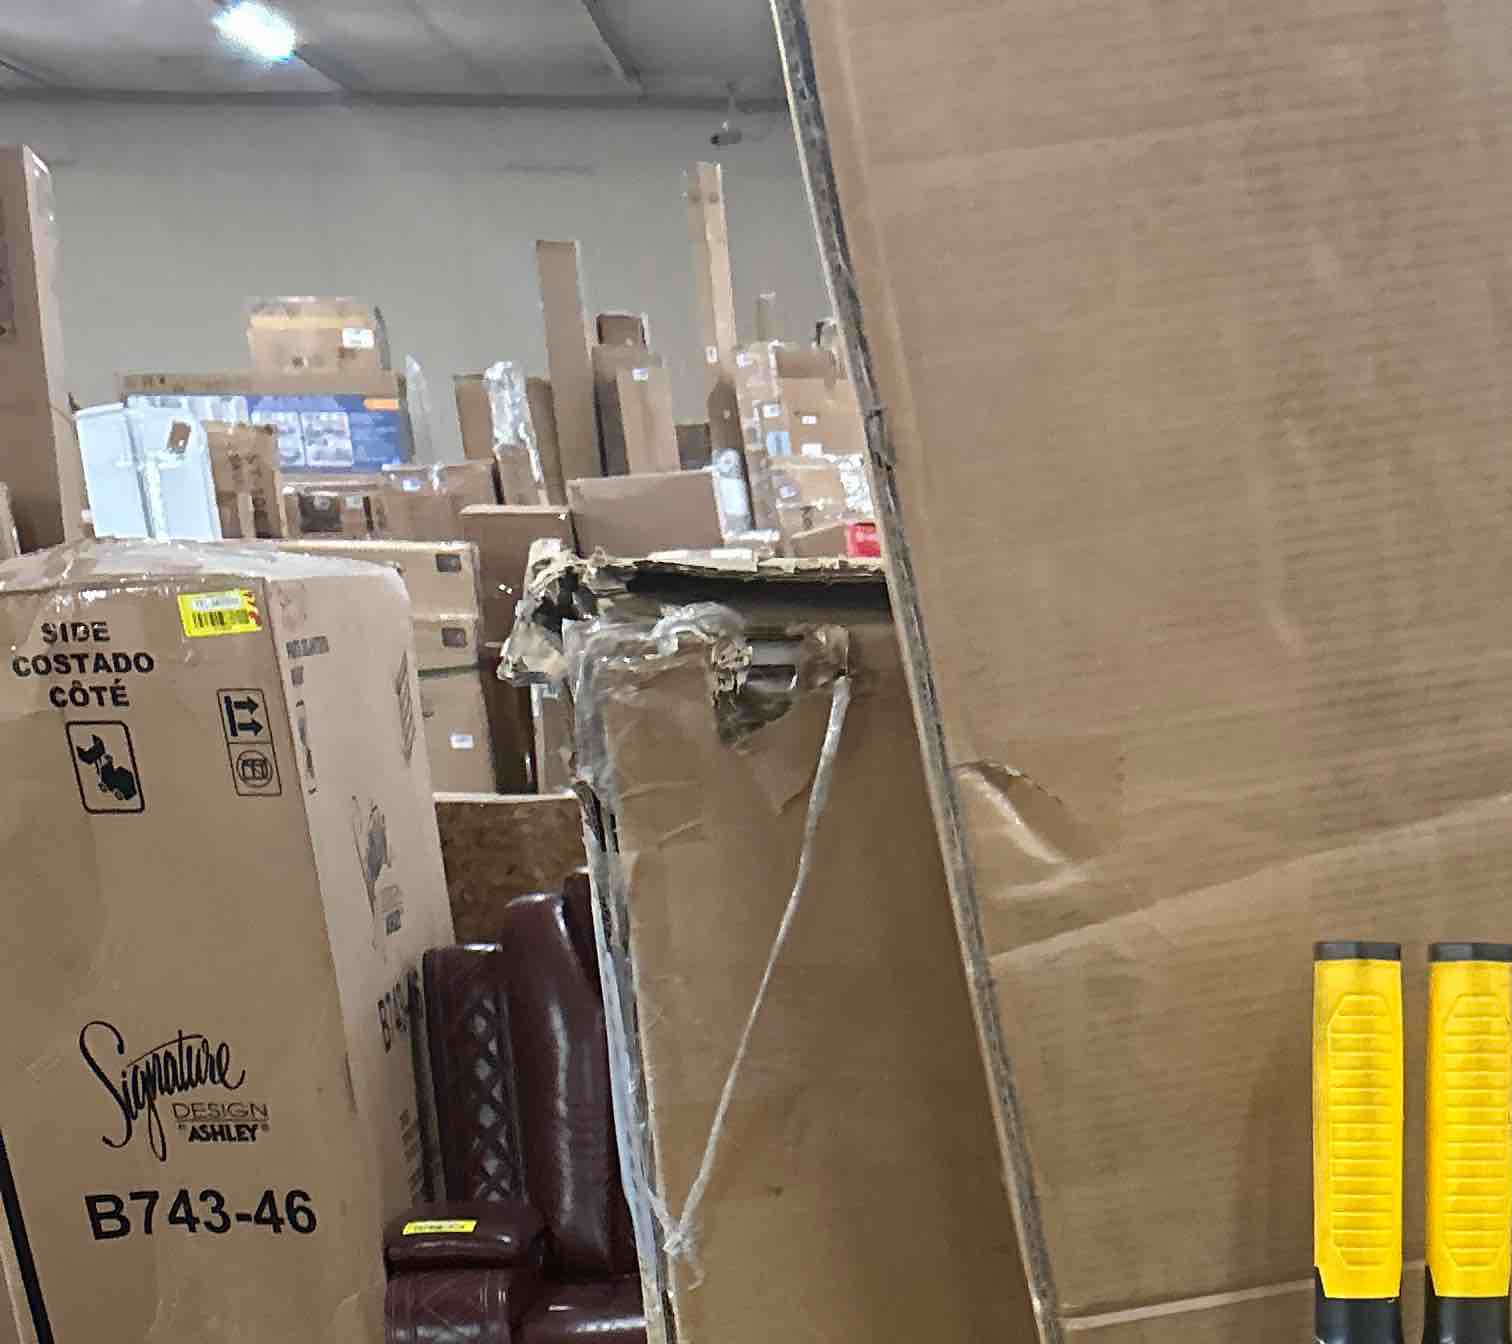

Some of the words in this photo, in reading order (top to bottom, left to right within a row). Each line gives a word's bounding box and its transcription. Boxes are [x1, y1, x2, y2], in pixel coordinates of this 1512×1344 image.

[41, 621, 110, 643] SIDE
[12, 652, 155, 677] COSTADO
[49, 678, 130, 708] CÔTÉ
[79, 1020, 246, 1162] Signature
[172, 1102, 269, 1121] DESIGN
[188, 1123, 259, 1142] ASHLEY
[84, 1188, 318, 1241] B743-46
